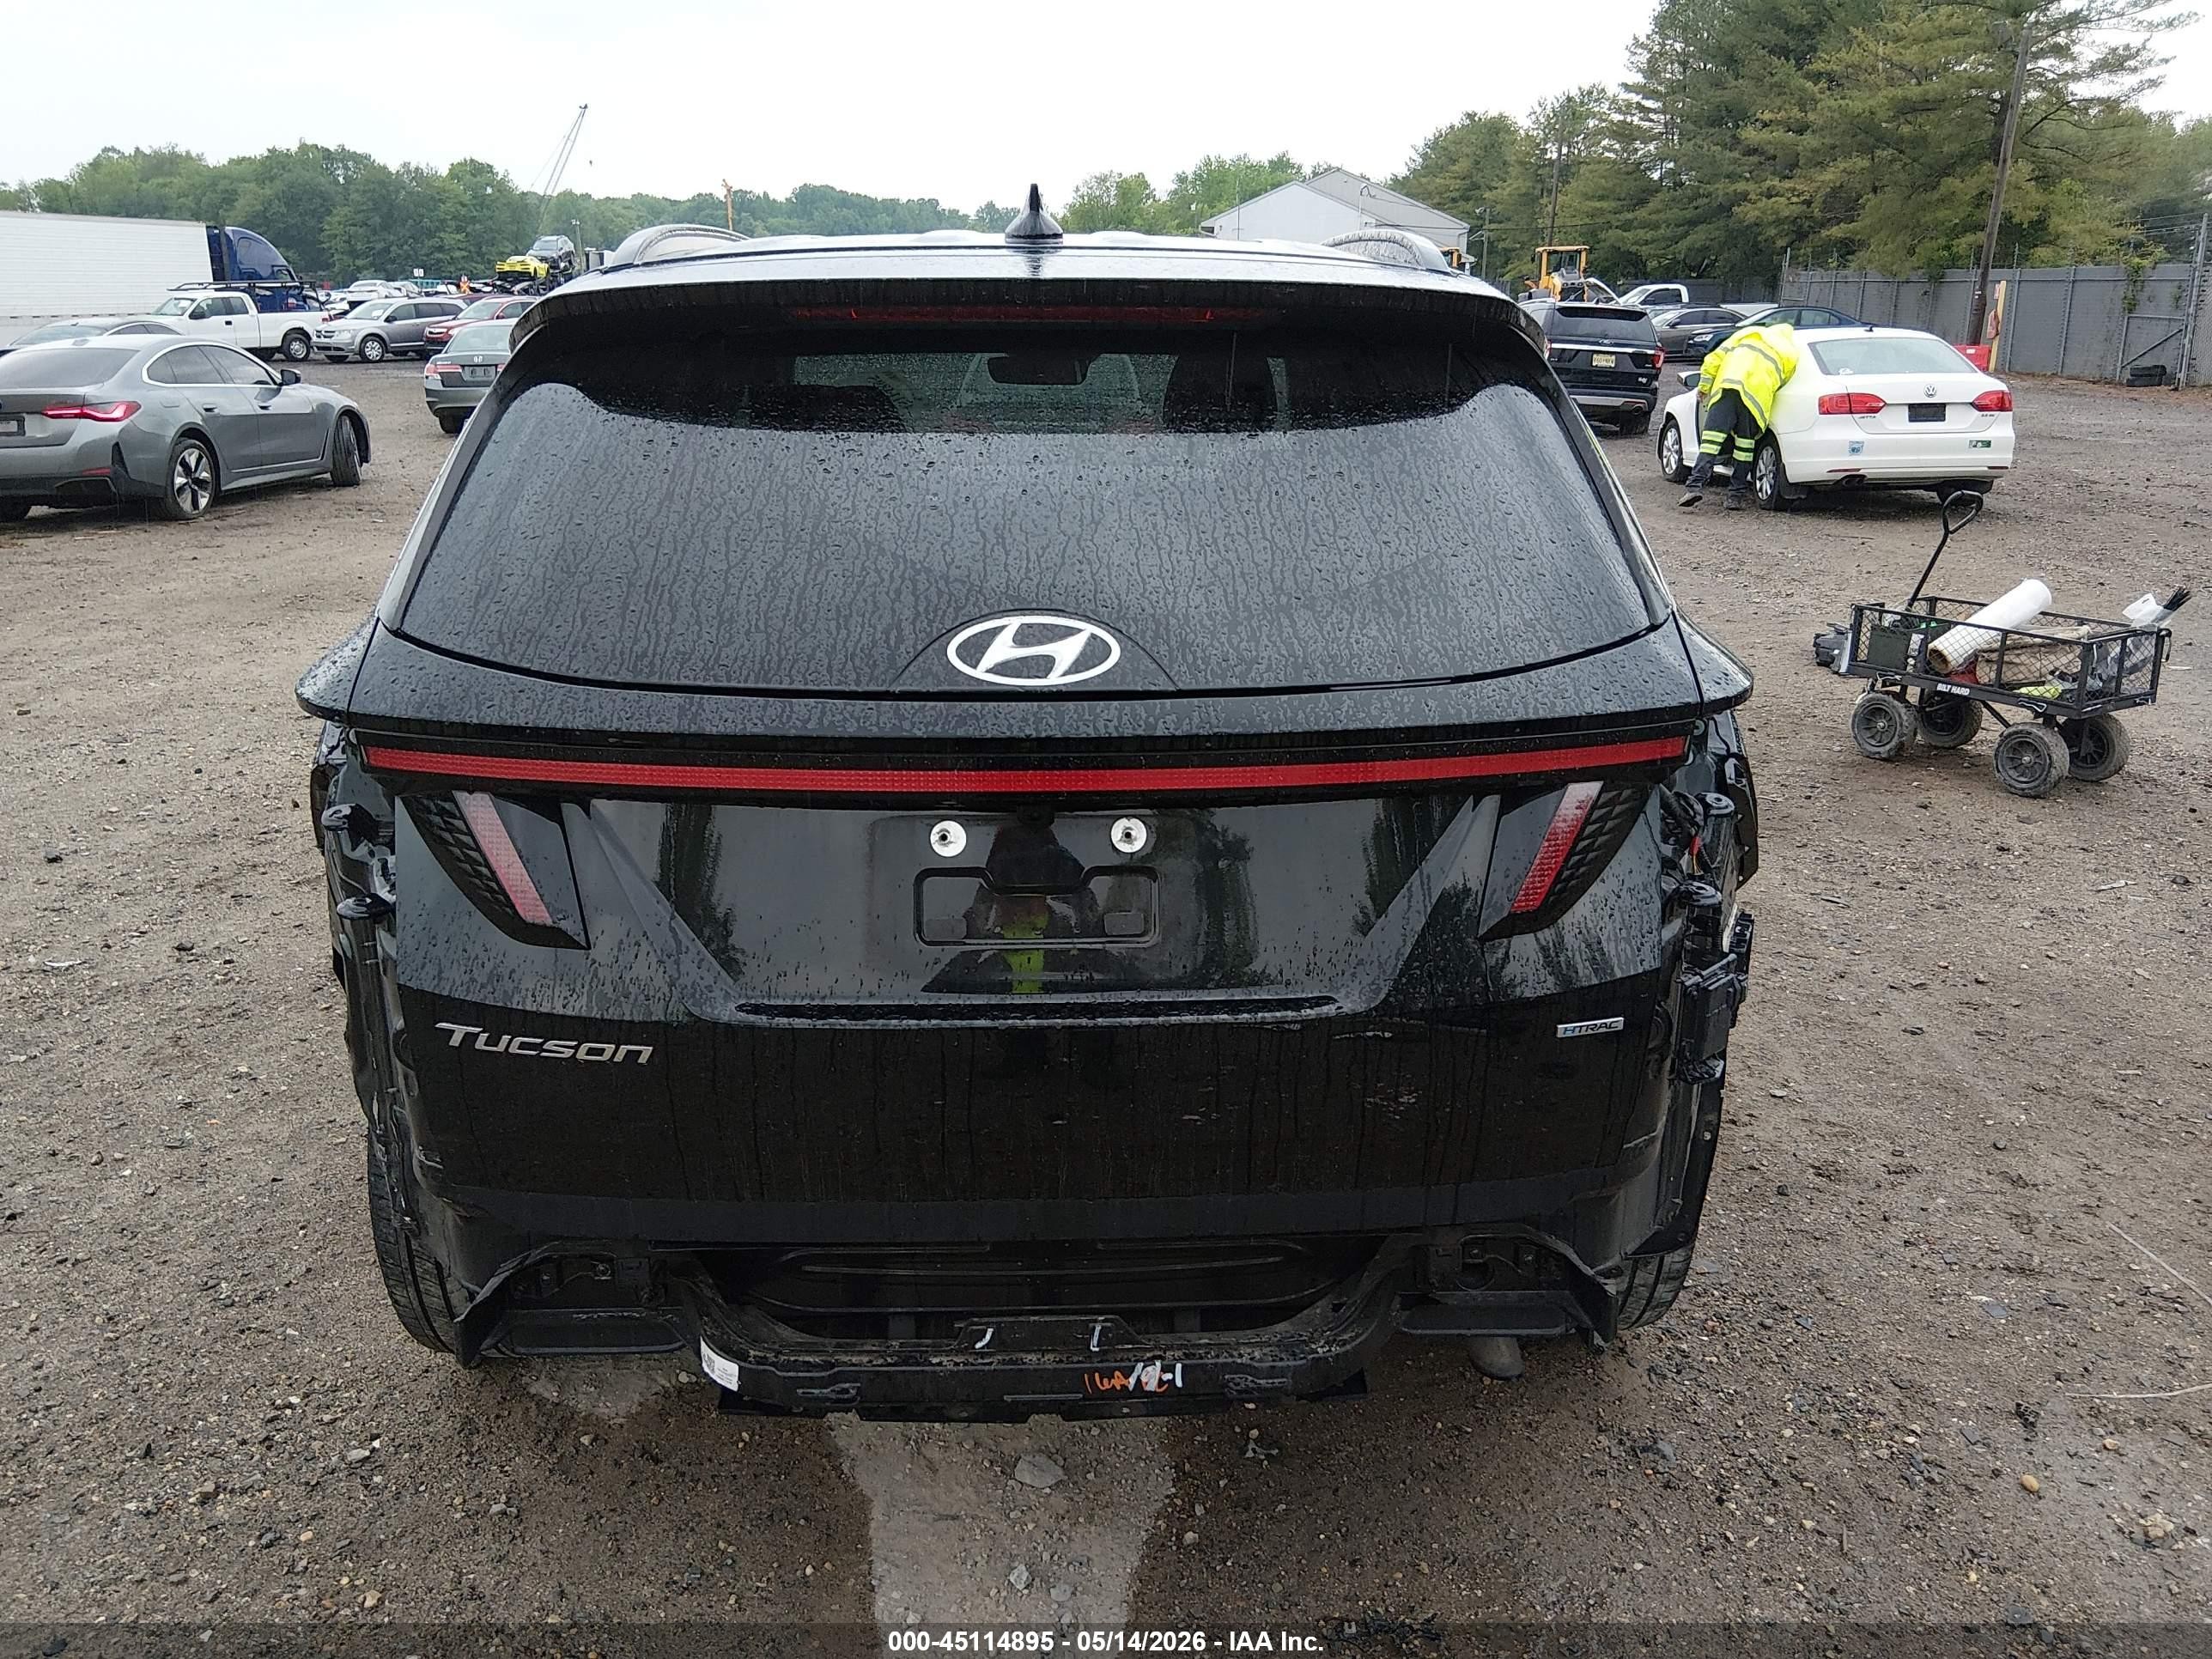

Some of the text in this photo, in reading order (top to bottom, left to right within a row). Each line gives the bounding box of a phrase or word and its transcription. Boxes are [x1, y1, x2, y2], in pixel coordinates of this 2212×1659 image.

[1937, 684, 1970, 696] BILT HARD
[1563, 1020, 1620, 1035] HTRAC
